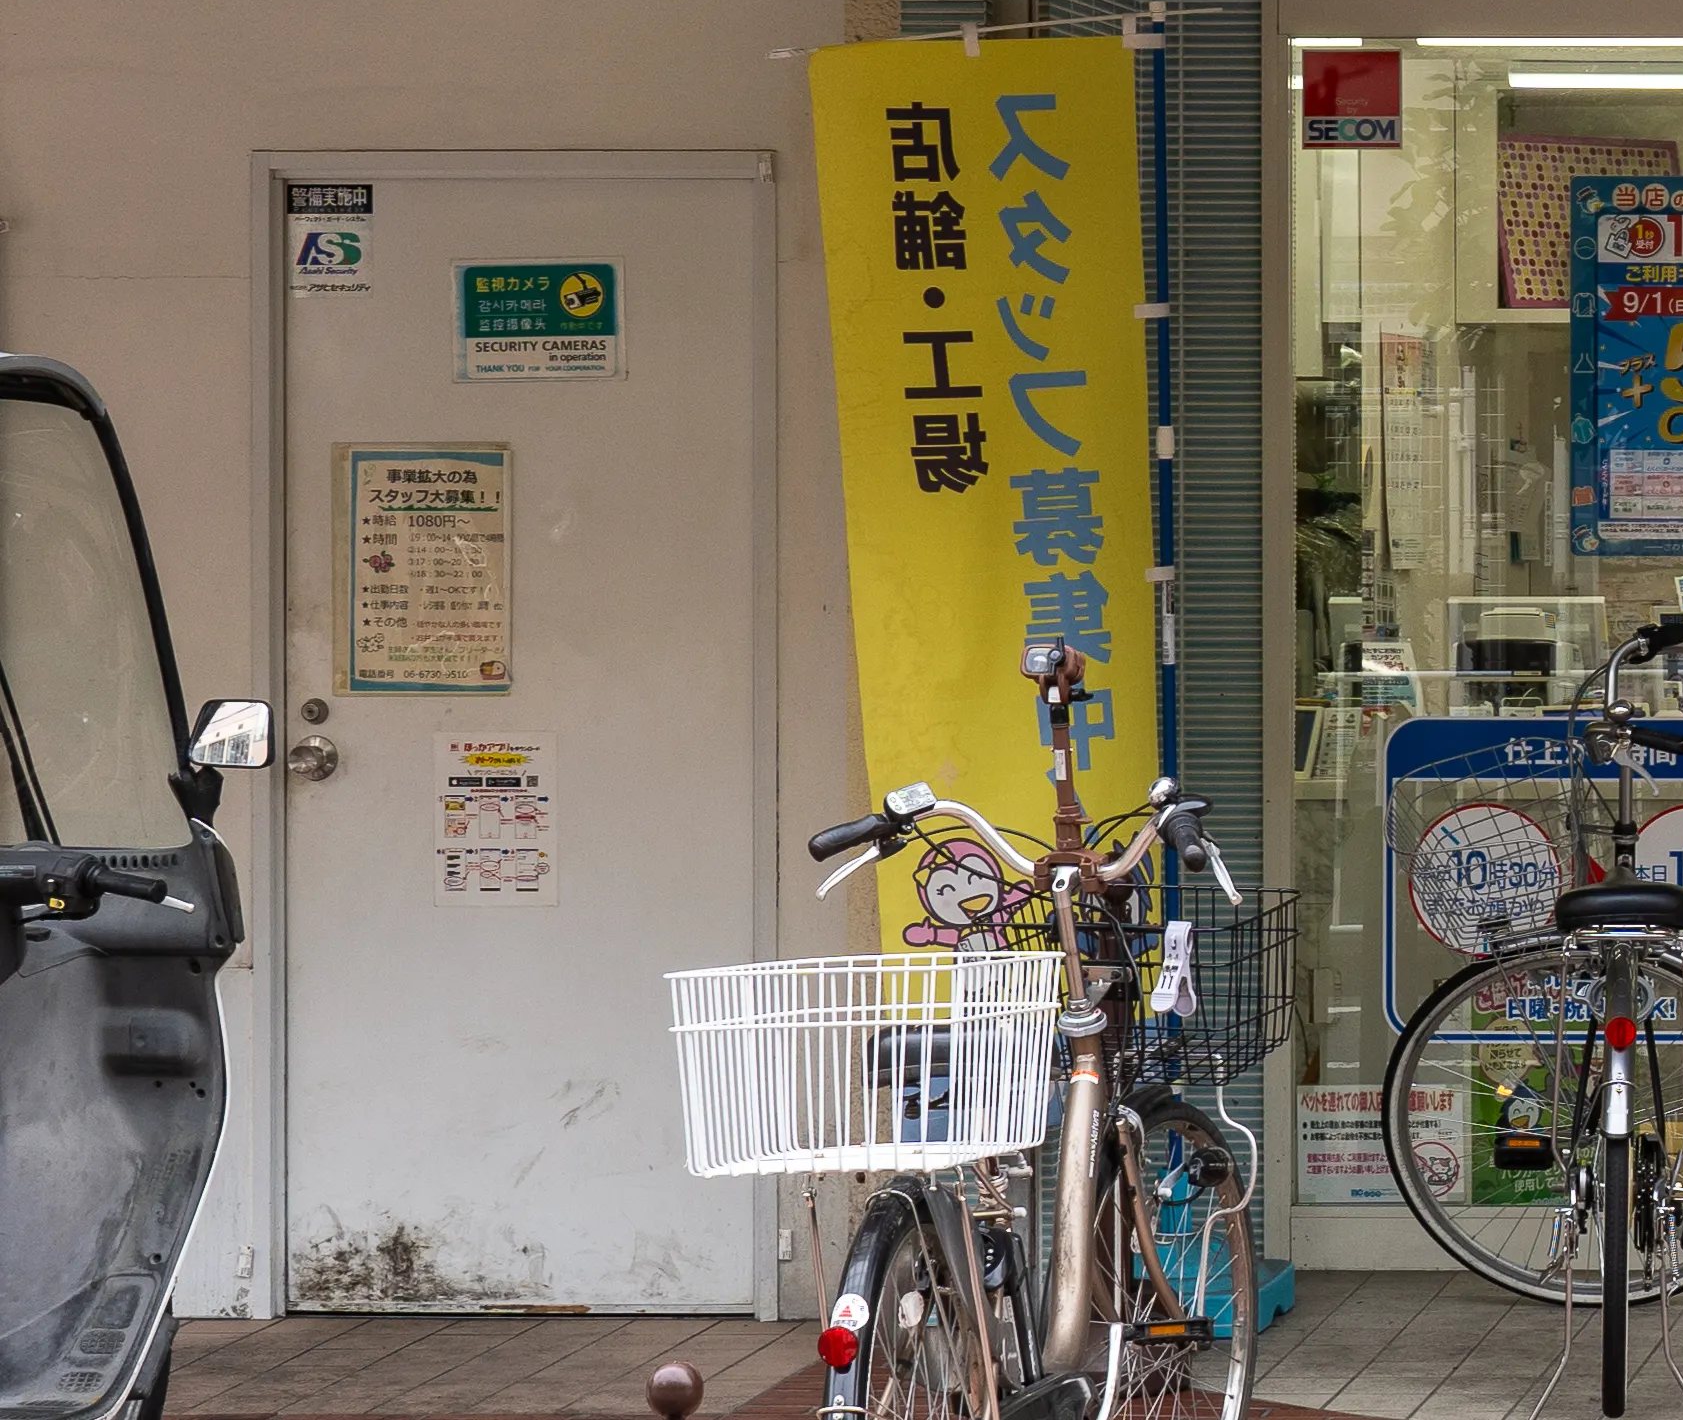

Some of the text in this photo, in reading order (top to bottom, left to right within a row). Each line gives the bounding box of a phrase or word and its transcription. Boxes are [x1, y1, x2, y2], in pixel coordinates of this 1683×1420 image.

[1309, 119, 1395, 141] SECOM
[292, 187, 367, 206] 警備実施中
[1635, 239, 1654, 249] 受付
[325, 267, 358, 275] Security
[476, 277, 550, 292] 監視カメラ
[478, 300, 546, 312] 감시카메라
[476, 340, 606, 353] SECURITY CAMERAS
[549, 352, 606, 363] in operation
[1620, 354, 1657, 375] プラス
[387, 469, 477, 484] 事業拡大の為
[372, 515, 397, 526] 時給
[372, 534, 397, 545] 時間
[370, 584, 409, 594] 出勤日数
[370, 601, 409, 610] 仕事内容
[374, 617, 408, 628] その他
[359, 670, 394, 678] 電話番号
